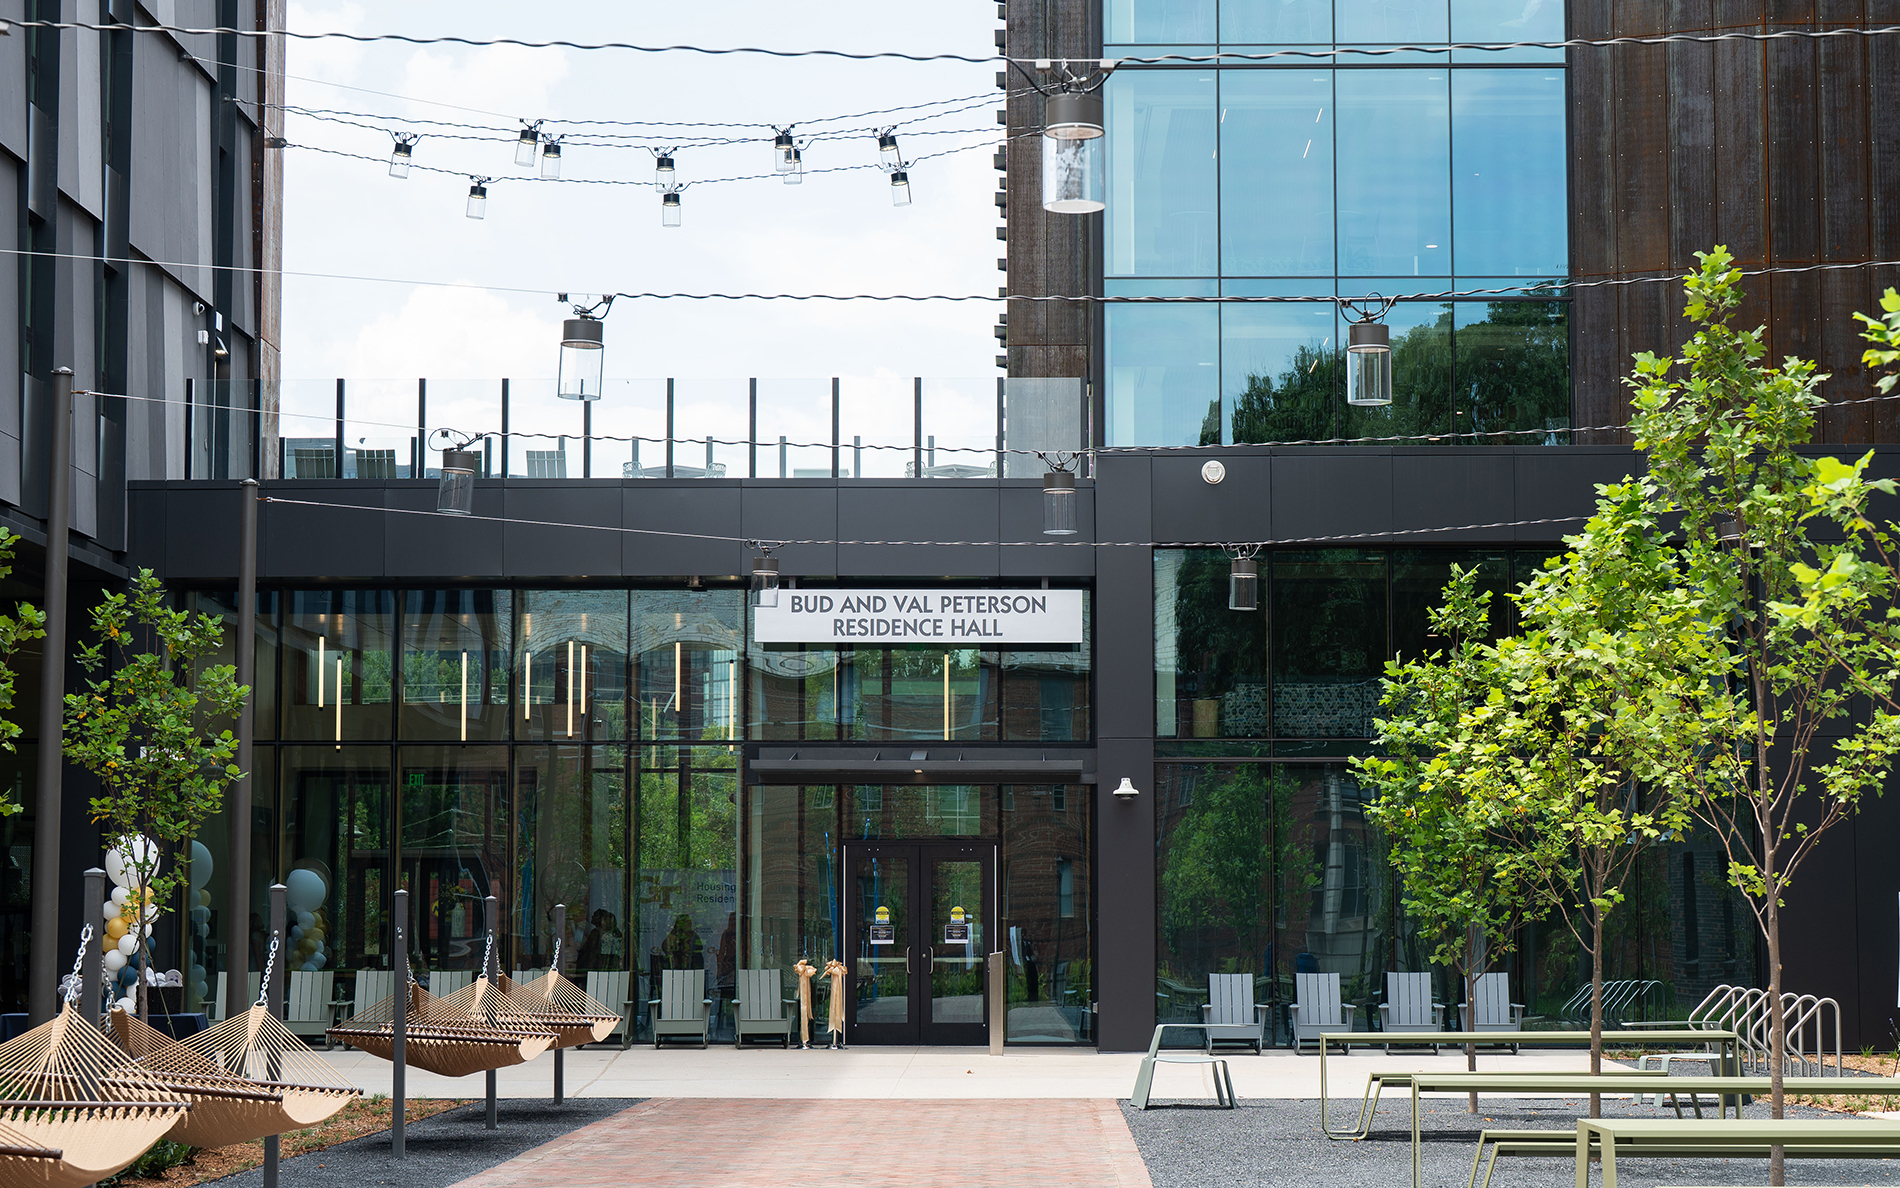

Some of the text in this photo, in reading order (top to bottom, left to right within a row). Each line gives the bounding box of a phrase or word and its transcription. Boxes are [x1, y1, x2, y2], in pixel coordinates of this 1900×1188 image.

[791, 595, 1046, 614] BUD AND VAL PETERSON
[833, 618, 1003, 637] RESIDENCE HALL
[409, 773, 425, 785] EXIT
[696, 881, 736, 893] Housing
